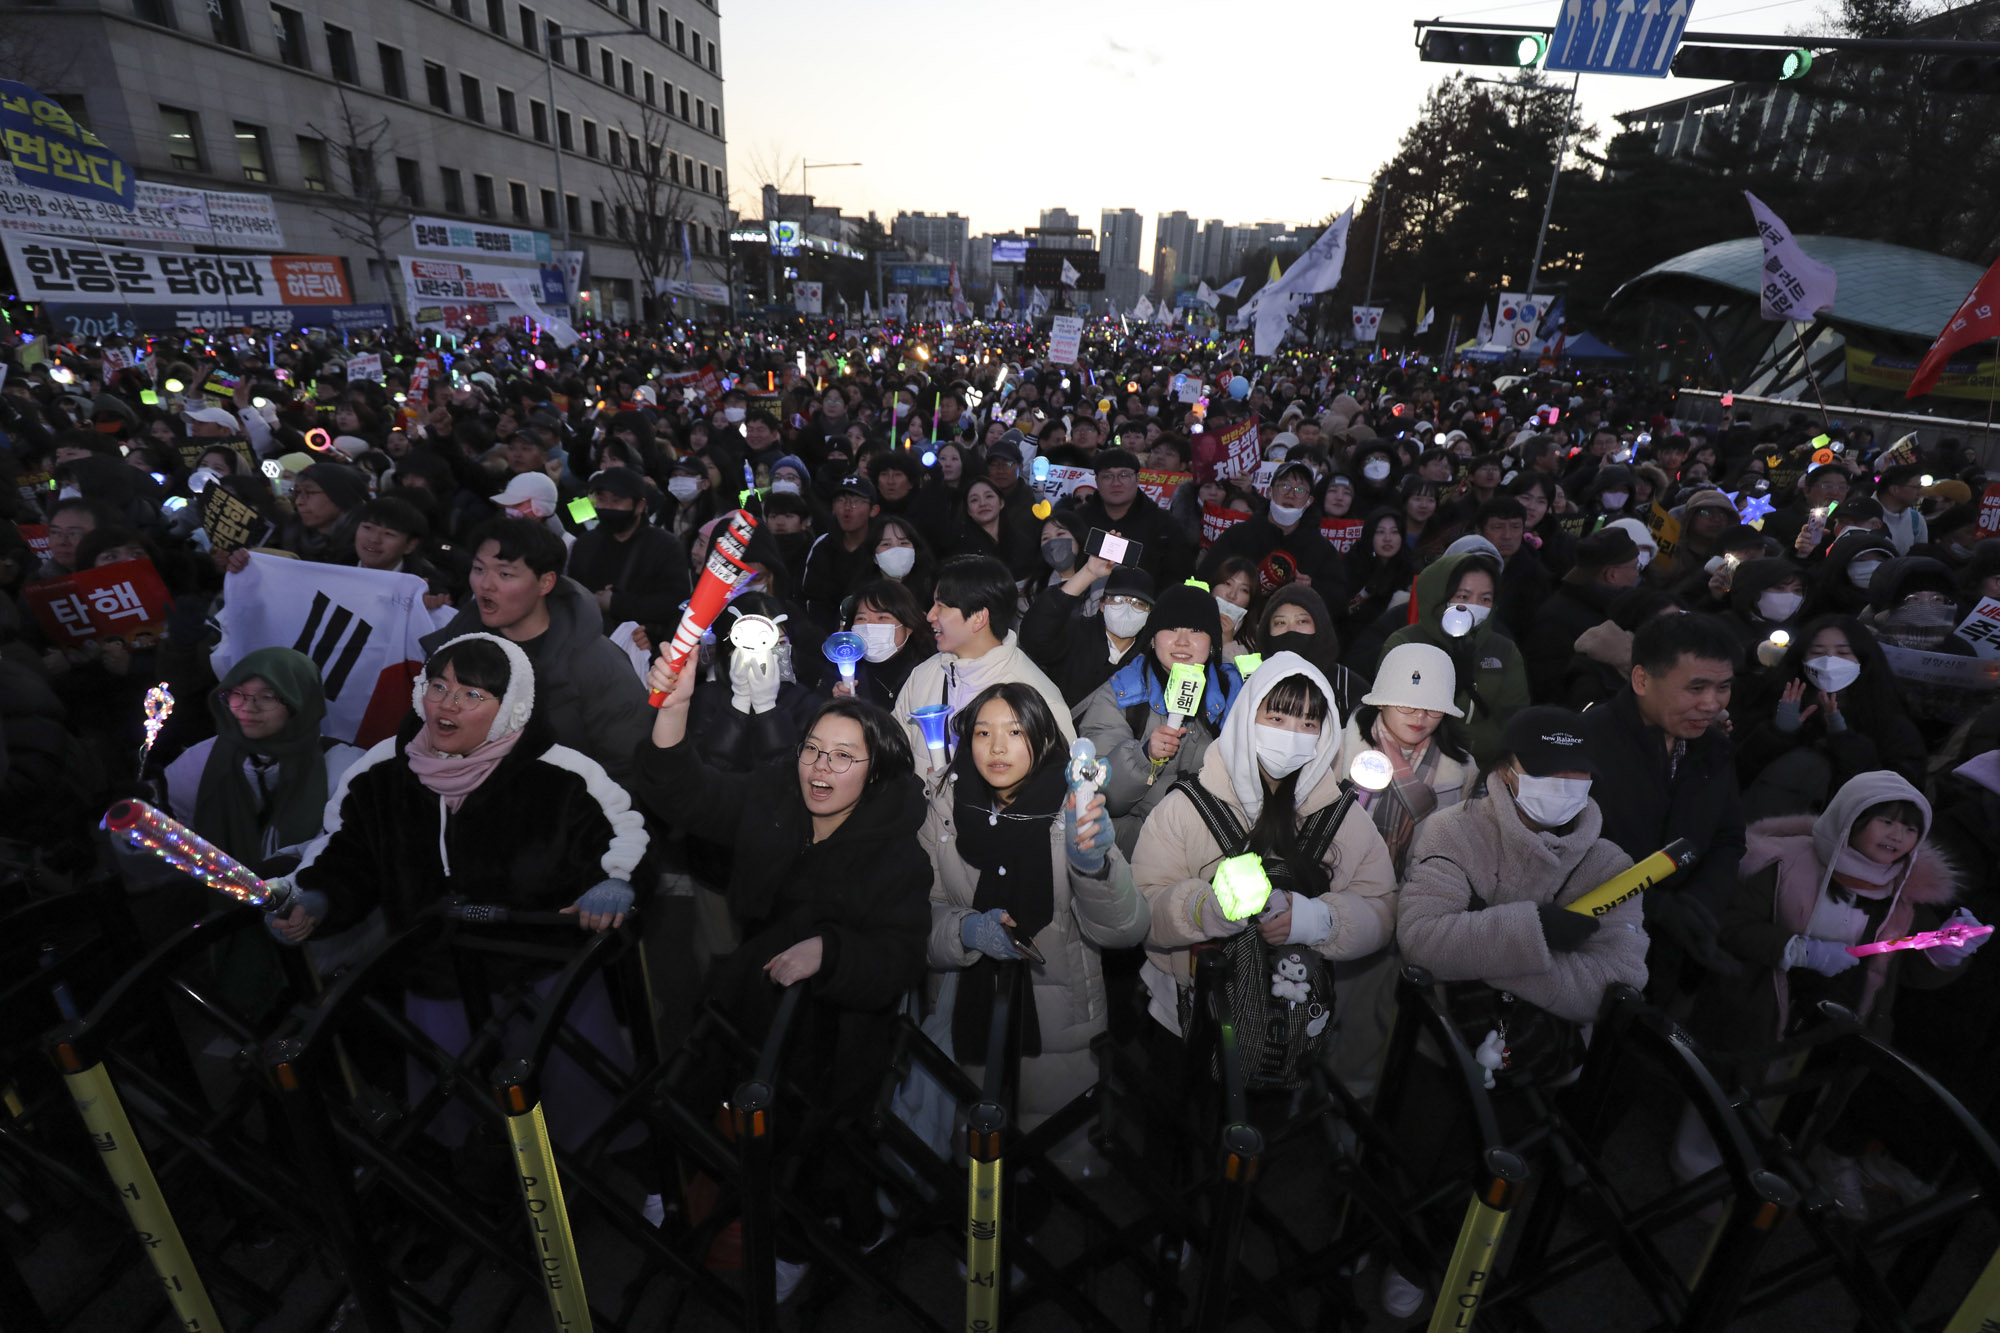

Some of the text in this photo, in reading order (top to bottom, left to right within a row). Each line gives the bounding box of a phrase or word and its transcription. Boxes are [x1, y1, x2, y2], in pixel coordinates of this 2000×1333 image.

[21, 244, 264, 297] 한동훈 답하라
[286, 274, 343, 297] 허은아
[1763, 283, 1793, 313] 연합
[1228, 424, 1258, 457] 윤석열
[1069, 470, 1085, 480] 윤석
[1213, 439, 1260, 481] 체포!
[1204, 514, 1232, 528] 내란동조
[1979, 508, 2000, 532] 해
[49, 581, 151, 638] 탄핵
[1177, 681, 1198, 713] 탄핵
[1556, 736, 1582, 744] Balance
[521, 1175, 564, 1290] POLICE
[1454, 1270, 1486, 1333] POL
